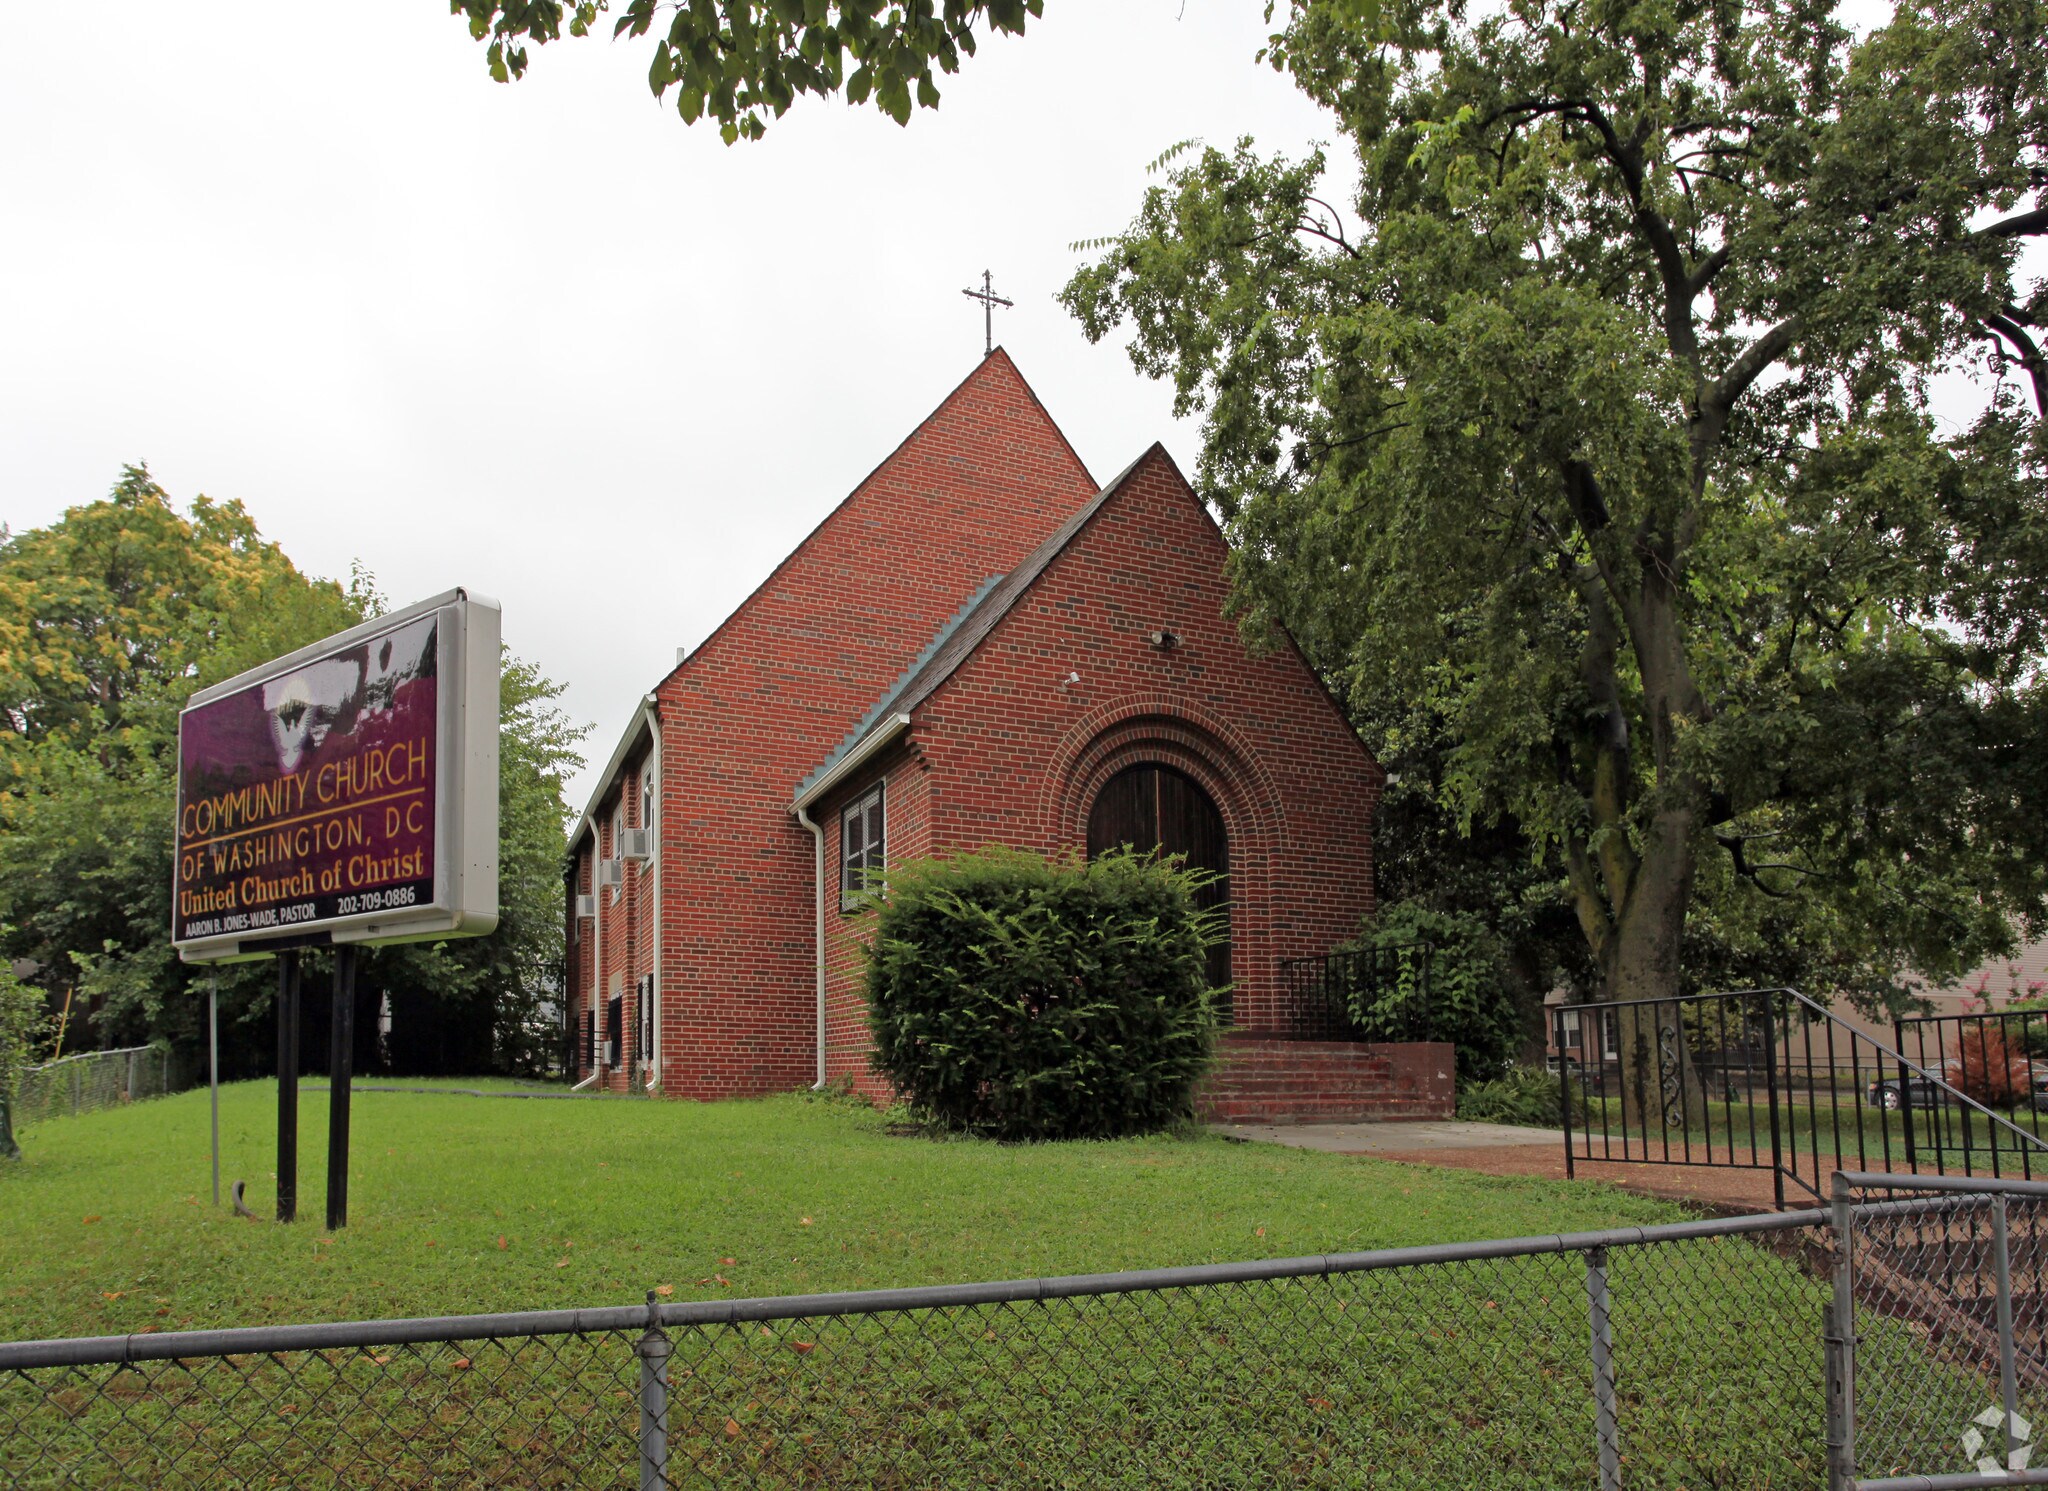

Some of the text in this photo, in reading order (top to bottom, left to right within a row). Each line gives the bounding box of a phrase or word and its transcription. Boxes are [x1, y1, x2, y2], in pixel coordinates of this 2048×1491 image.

[183, 737, 426, 838] COMMUNITY CHURCH
[180, 846, 424, 917] United Church of Christ
[182, 851, 205, 881] OF
[213, 816, 372, 875] WASHINGTON,
[185, 886, 416, 938] AARON B. JONES-WADE, PASTOR 202-709-0886
